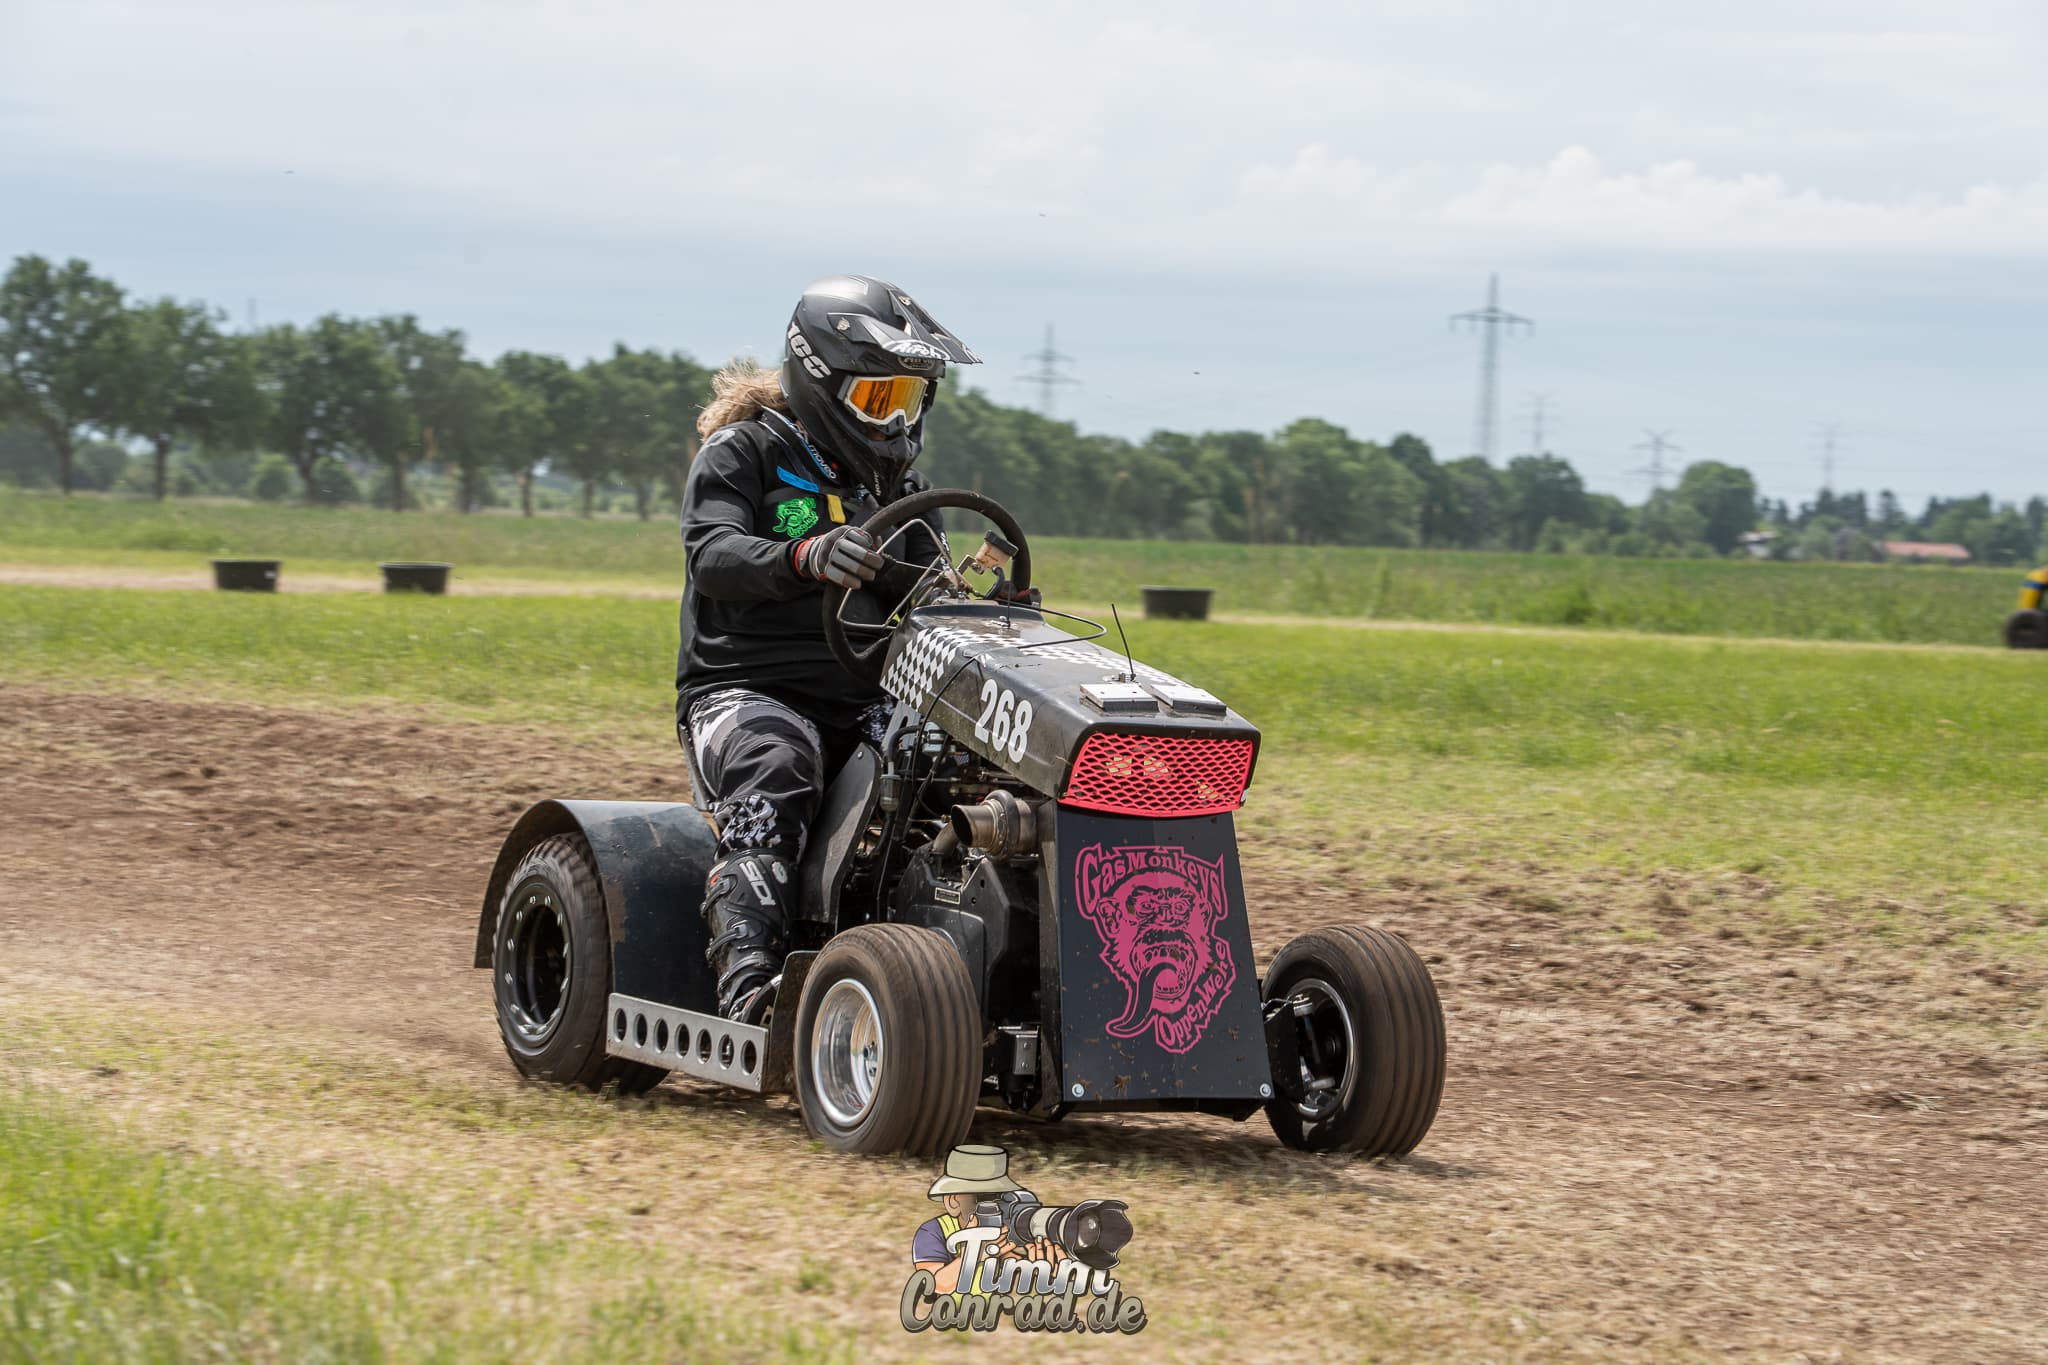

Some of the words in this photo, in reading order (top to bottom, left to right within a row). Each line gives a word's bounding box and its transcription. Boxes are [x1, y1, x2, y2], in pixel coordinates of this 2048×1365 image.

[975, 679, 1032, 763] 268
[1082, 852, 1126, 914] Gas
[1126, 852, 1222, 914] Monkeys
